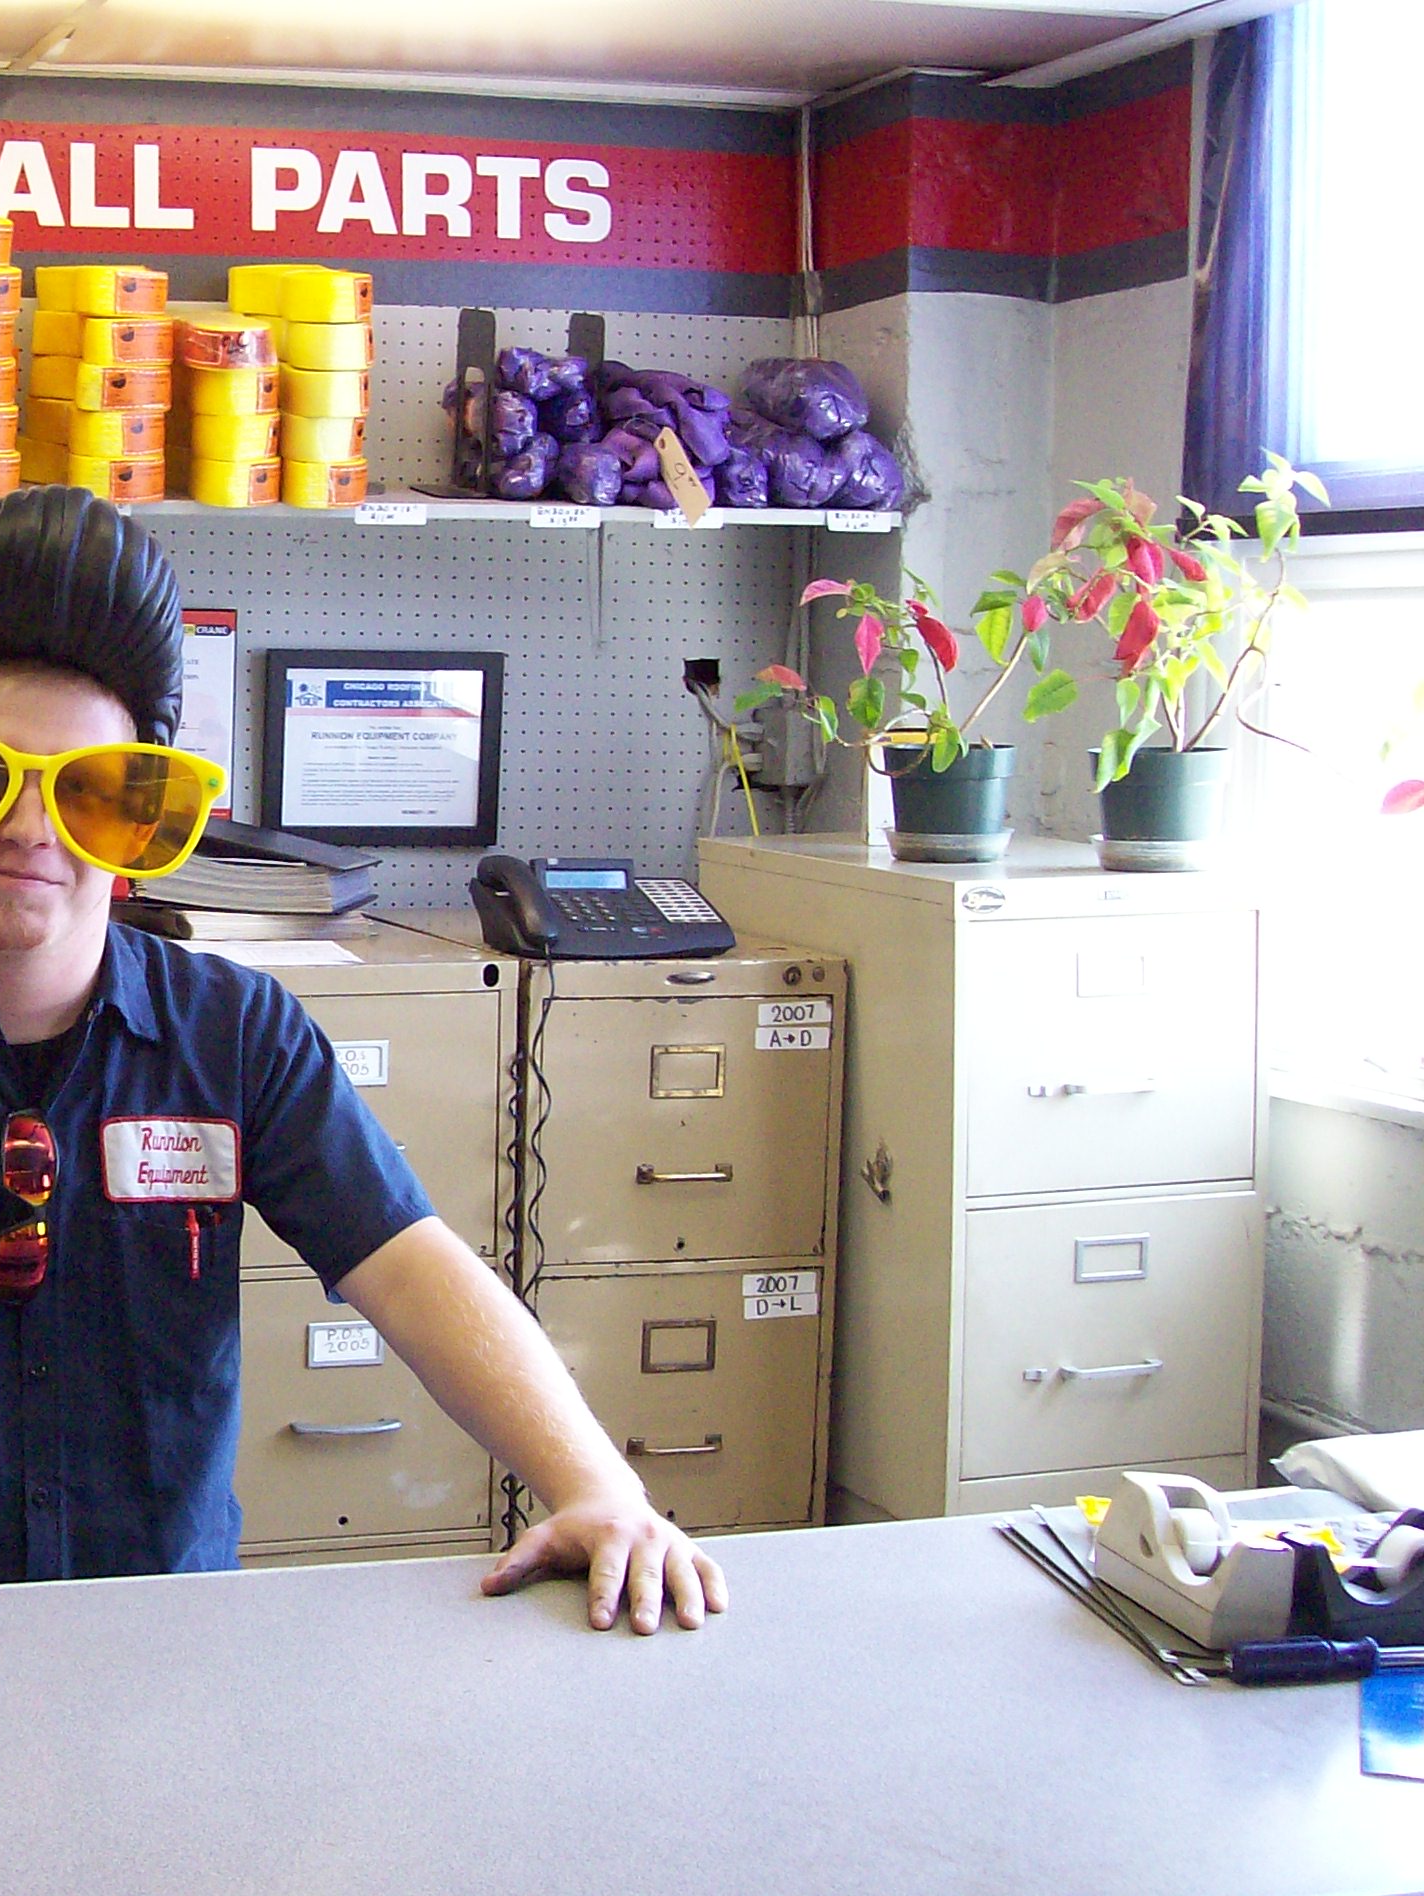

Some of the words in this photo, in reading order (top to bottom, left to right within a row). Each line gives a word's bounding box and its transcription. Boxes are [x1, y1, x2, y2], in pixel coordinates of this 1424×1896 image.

[251, 147, 611, 243] PARTS
[343, 683, 385, 691] CHICAGO
[333, 699, 400, 708] CONTRACTORS
[311, 731, 354, 741] RUNNION
[357, 731, 410, 742] EQUIPMENT
[412, 731, 458, 742] COMPANY
[771, 1004, 815, 1022] 2007
[140, 1127, 202, 1153] Runnion
[136, 1159, 209, 1190] Equipment
[756, 1275, 799, 1293] 2007
[324, 1338, 370, 1353] 2005
